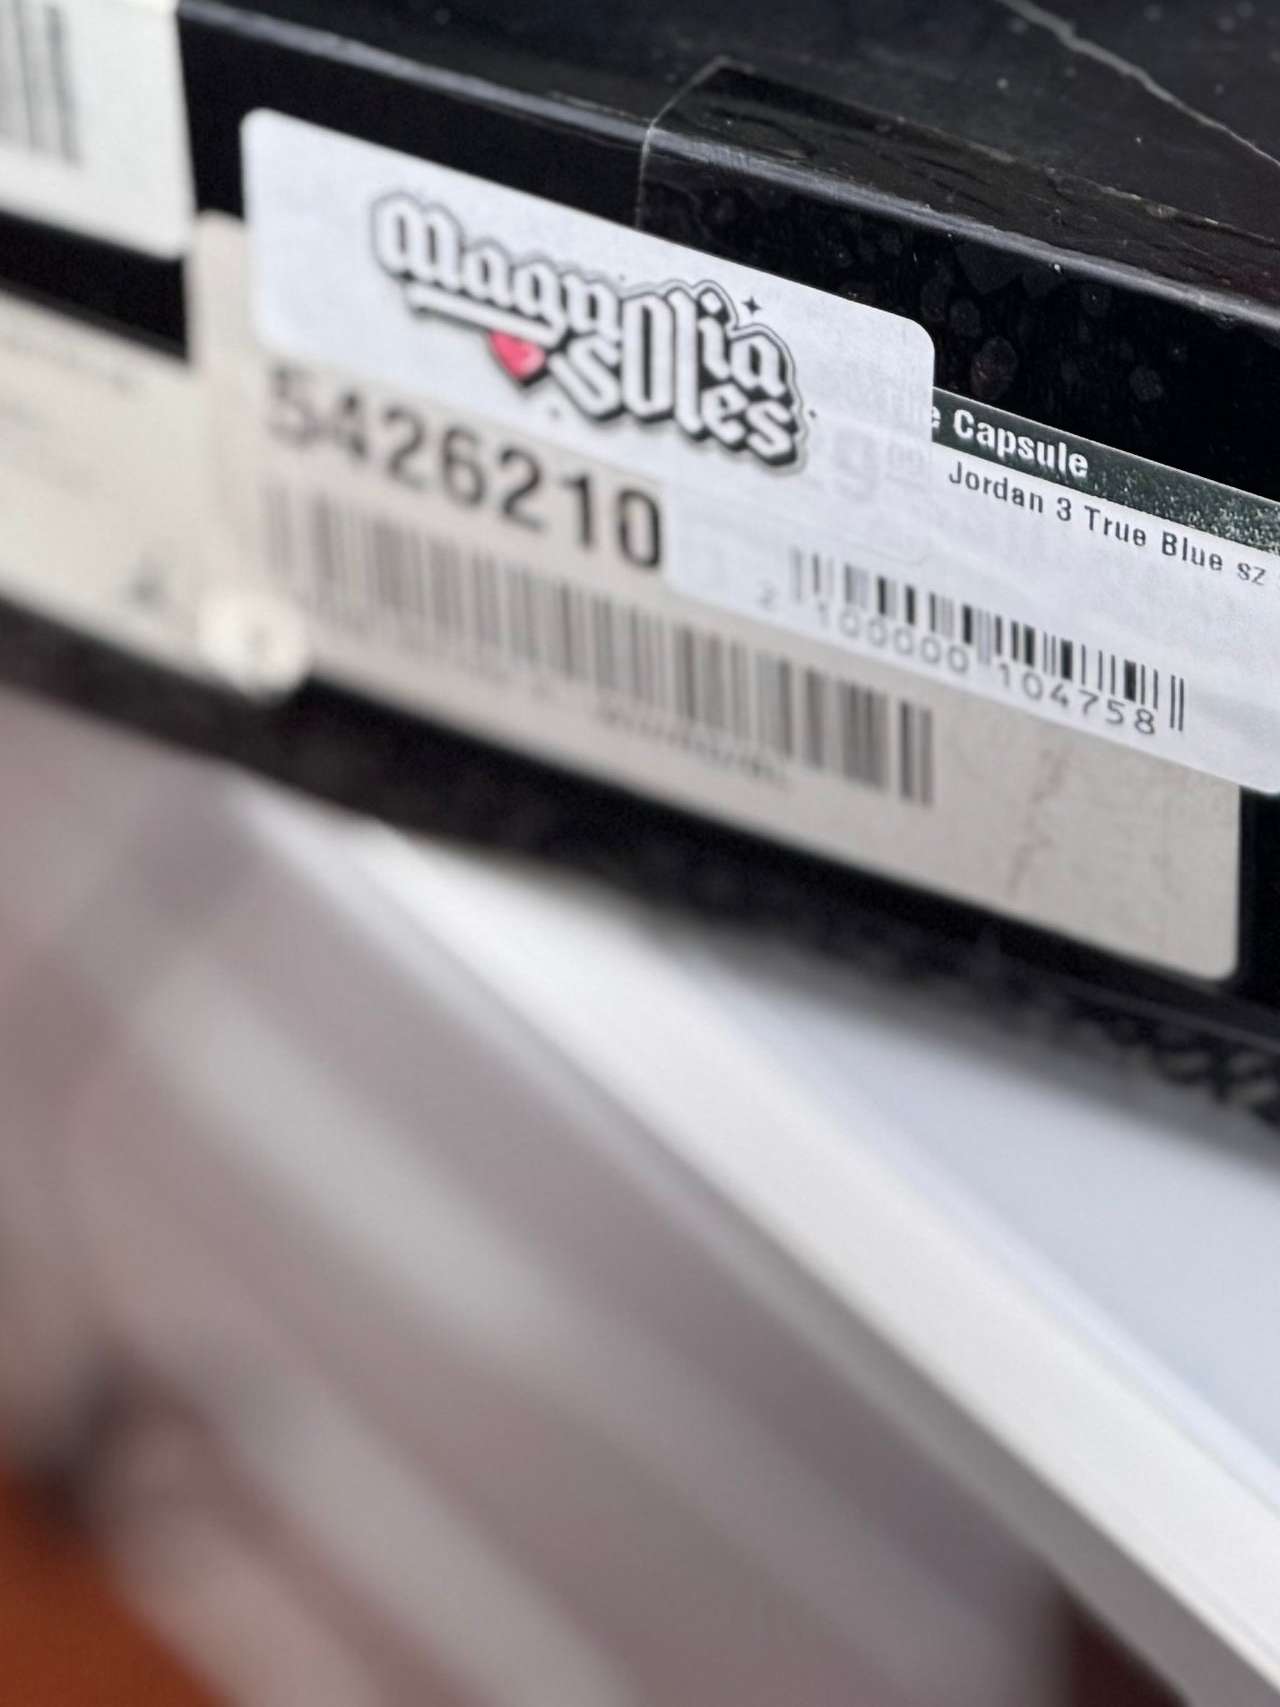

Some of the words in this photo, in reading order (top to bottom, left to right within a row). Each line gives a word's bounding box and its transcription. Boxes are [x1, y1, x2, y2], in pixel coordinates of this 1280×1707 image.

[373, 193, 792, 399] Magnolia
[270, 359, 663, 569] 5426210
[953, 408, 1089, 479] Capsule
[949, 461, 1045, 515] Jordan
[1056, 497, 1073, 523] 3
[1084, 505, 1147, 548] True
[1162, 531, 1224, 572] Blue
[1237, 562, 1267, 586] sz
[998, 662, 1156, 737] 104758
